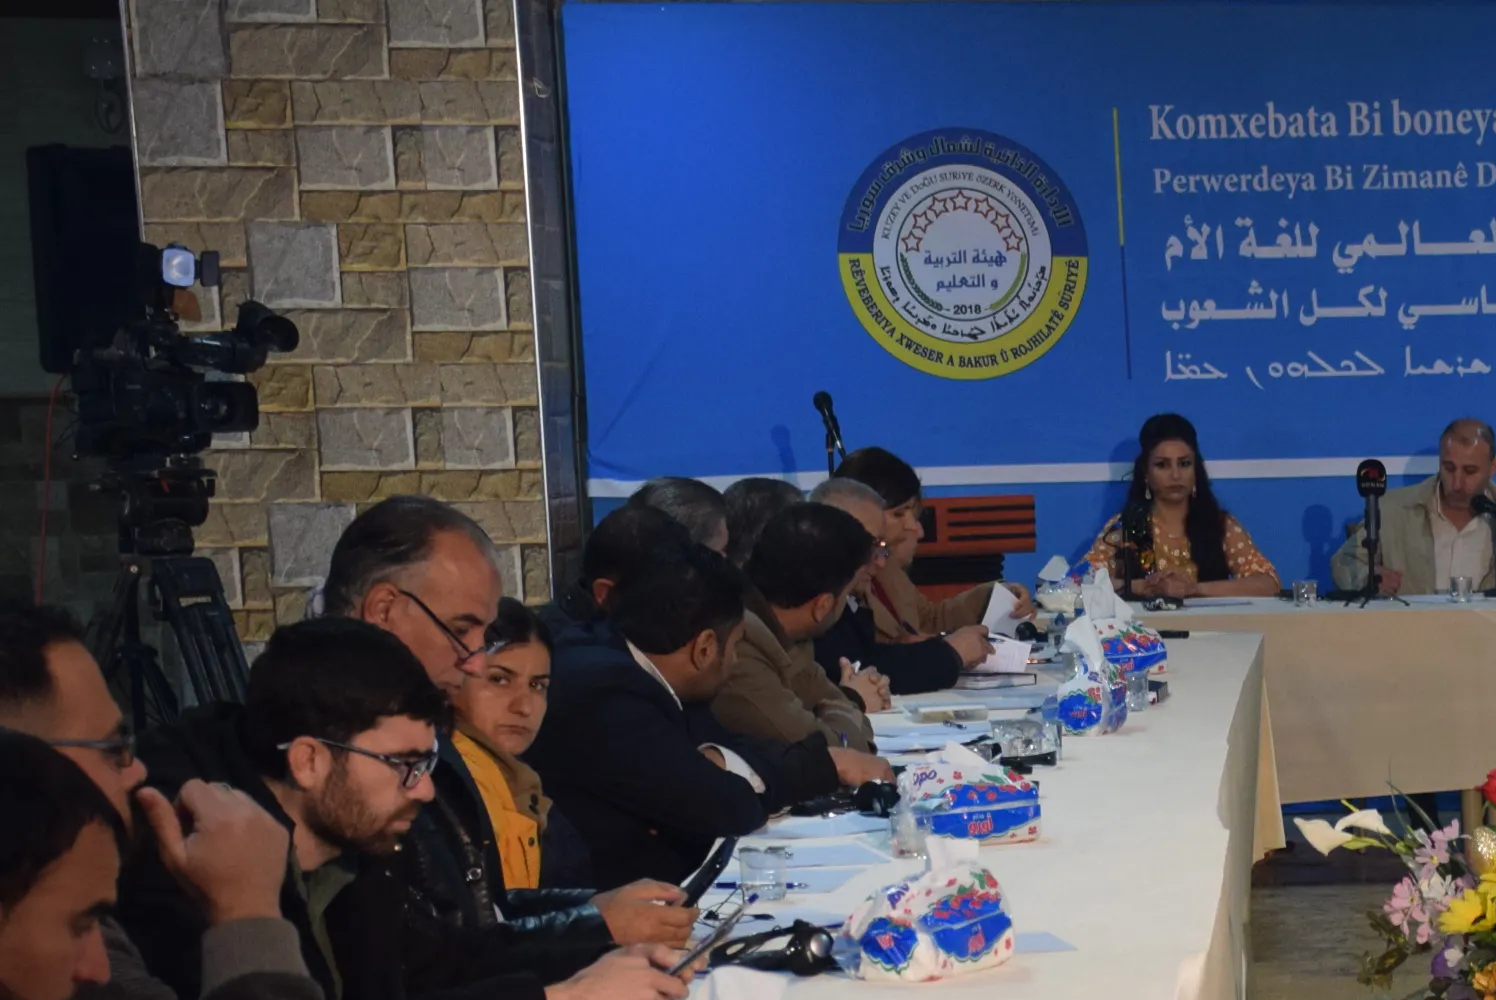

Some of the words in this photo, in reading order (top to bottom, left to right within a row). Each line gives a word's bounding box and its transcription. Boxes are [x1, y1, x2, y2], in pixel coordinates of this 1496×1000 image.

[1149, 101, 1339, 140] Komxebata
[1347, 101, 1383, 137] Bi
[1153, 164, 1317, 200] Perwerdeya
[1325, 165, 1354, 191] Bi
[1362, 161, 1469, 190] Zimanê
[923, 249, 967, 268] التربية
[972, 249, 1007, 267] هيئة
[936, 273, 985, 292] التعليم
[953, 304, 982, 315] 2018
[946, 355, 955, 367] A
[958, 354, 999, 368] BAKUR
